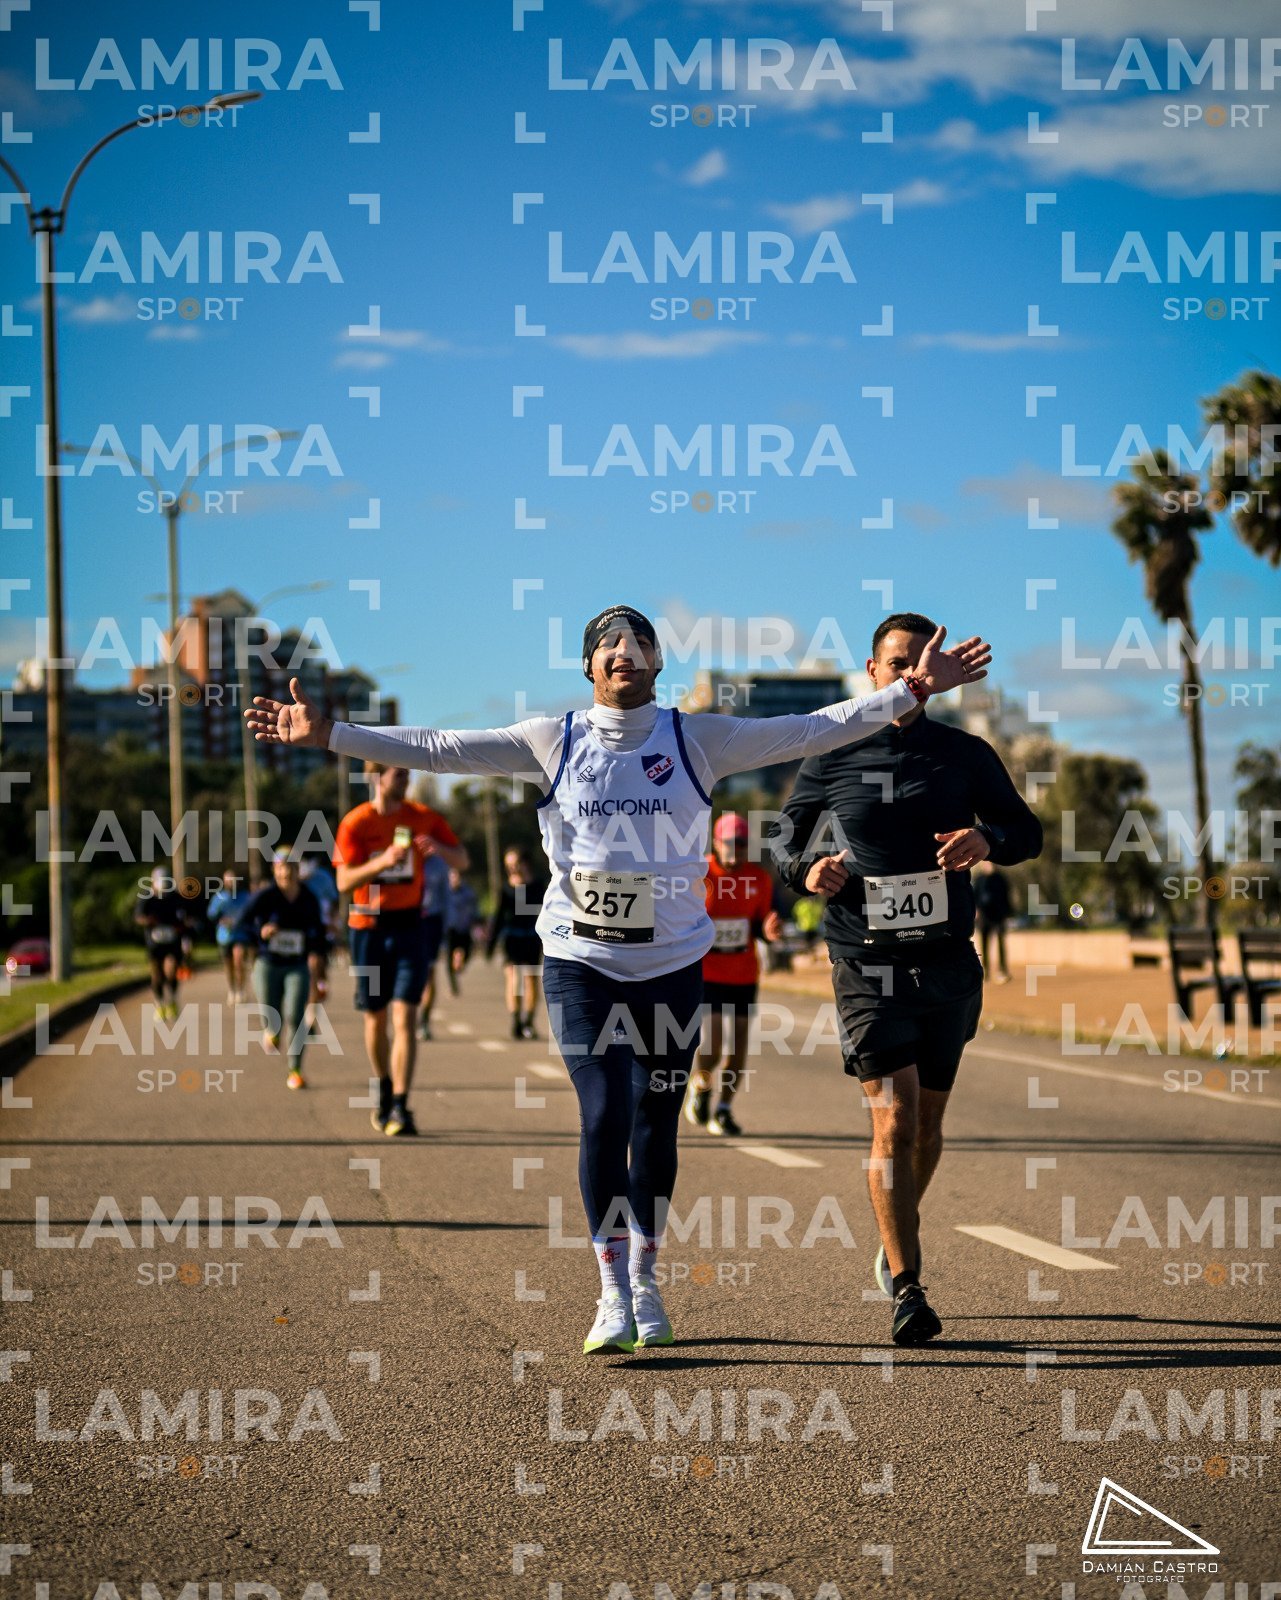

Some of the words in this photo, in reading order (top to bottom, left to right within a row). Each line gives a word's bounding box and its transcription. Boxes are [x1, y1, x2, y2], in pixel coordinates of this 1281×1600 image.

[578, 799, 672, 817] NACIONAL
[584, 890, 638, 919] 257
[880, 892, 934, 921] 340
